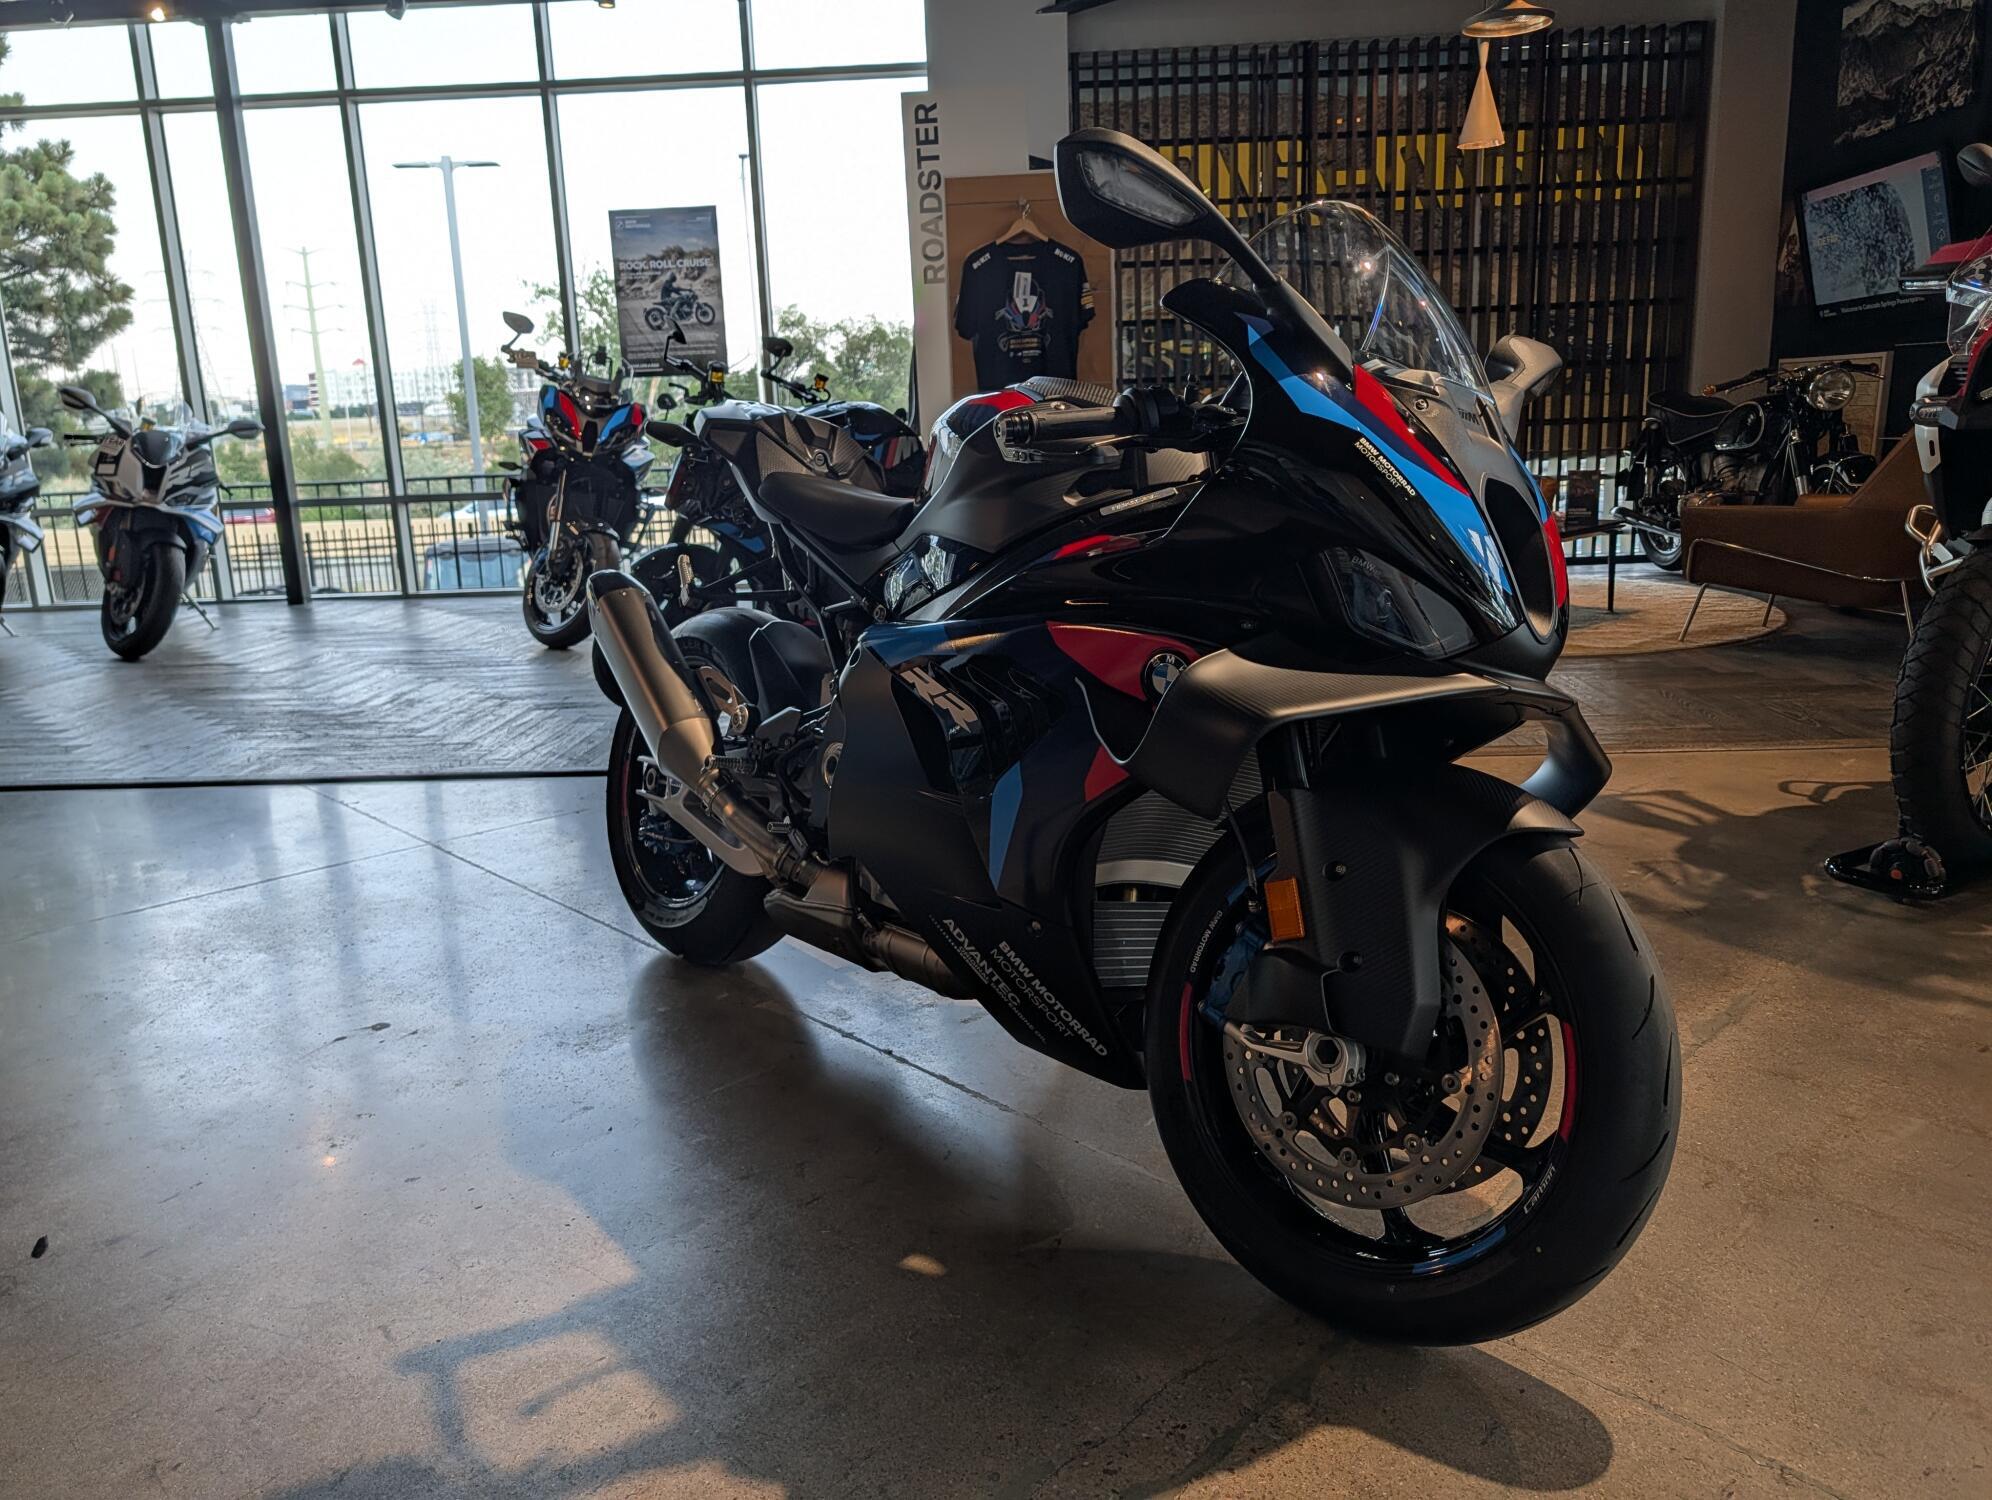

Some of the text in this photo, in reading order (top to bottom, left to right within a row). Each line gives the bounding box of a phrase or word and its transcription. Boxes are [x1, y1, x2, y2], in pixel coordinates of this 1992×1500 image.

[914, 102, 945, 285] ROADSTER
[1355, 442, 1401, 489] MOTORSPORT
[1359, 437, 1416, 497] BMW MOTORRAD
[943, 919, 1021, 1007] ADVANTEC
[990, 949, 1074, 1038] MOTORSPORT
[1190, 929, 1211, 973] MOTORRAD
[999, 941, 1108, 1056] BMW MOTORRAD
